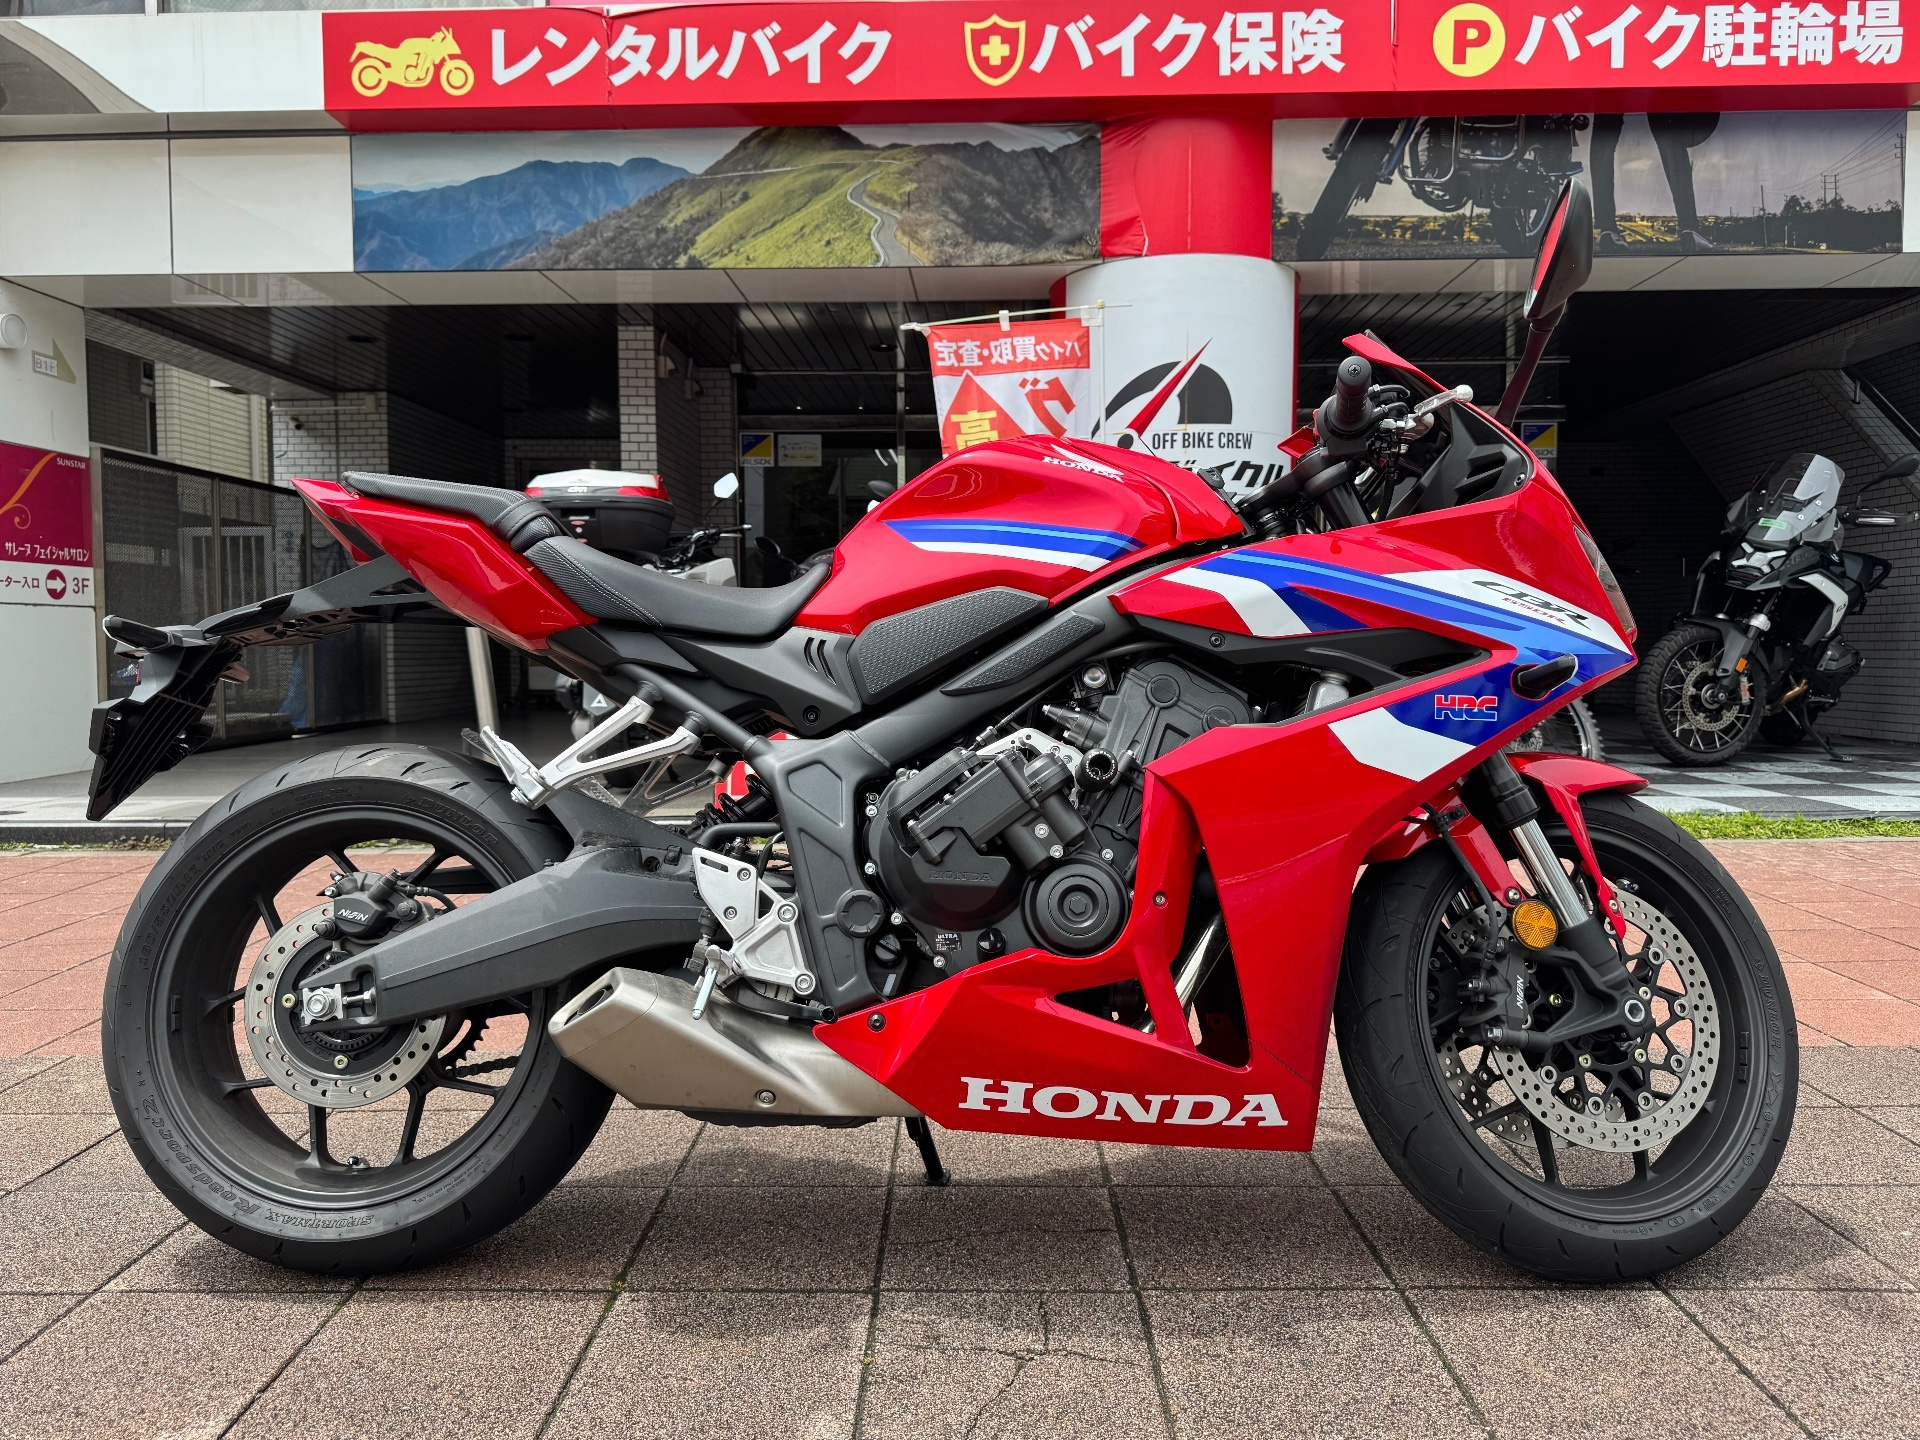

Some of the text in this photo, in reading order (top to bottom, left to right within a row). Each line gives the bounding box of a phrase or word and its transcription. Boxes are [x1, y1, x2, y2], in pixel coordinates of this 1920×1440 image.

[1028, 8, 1346, 78] バイク保険
[1514, 0, 1904, 70] バイク駐輪場
[491, 21, 893, 87] レンタルバイク
[36, 358, 56, 373] B1F
[1152, 432, 1253, 450] OFF BIKE CREW
[56, 457, 86, 470] SUNSTAR
[1042, 456, 1124, 484] HONDA
[5, 541, 90, 563] サレーヌ フェイシャルサロン
[72, 577, 90, 595] 3F
[1471, 580, 1592, 631] CBR
[1434, 694, 1498, 721] HRC
[418, 797, 498, 846] DUNLOP
[929, 870, 995, 882] HONDA
[1759, 974, 1783, 1049] DUNLOP
[958, 1076, 1289, 1127] HONDA
[264, 1208, 374, 1229] SPORTMAX
